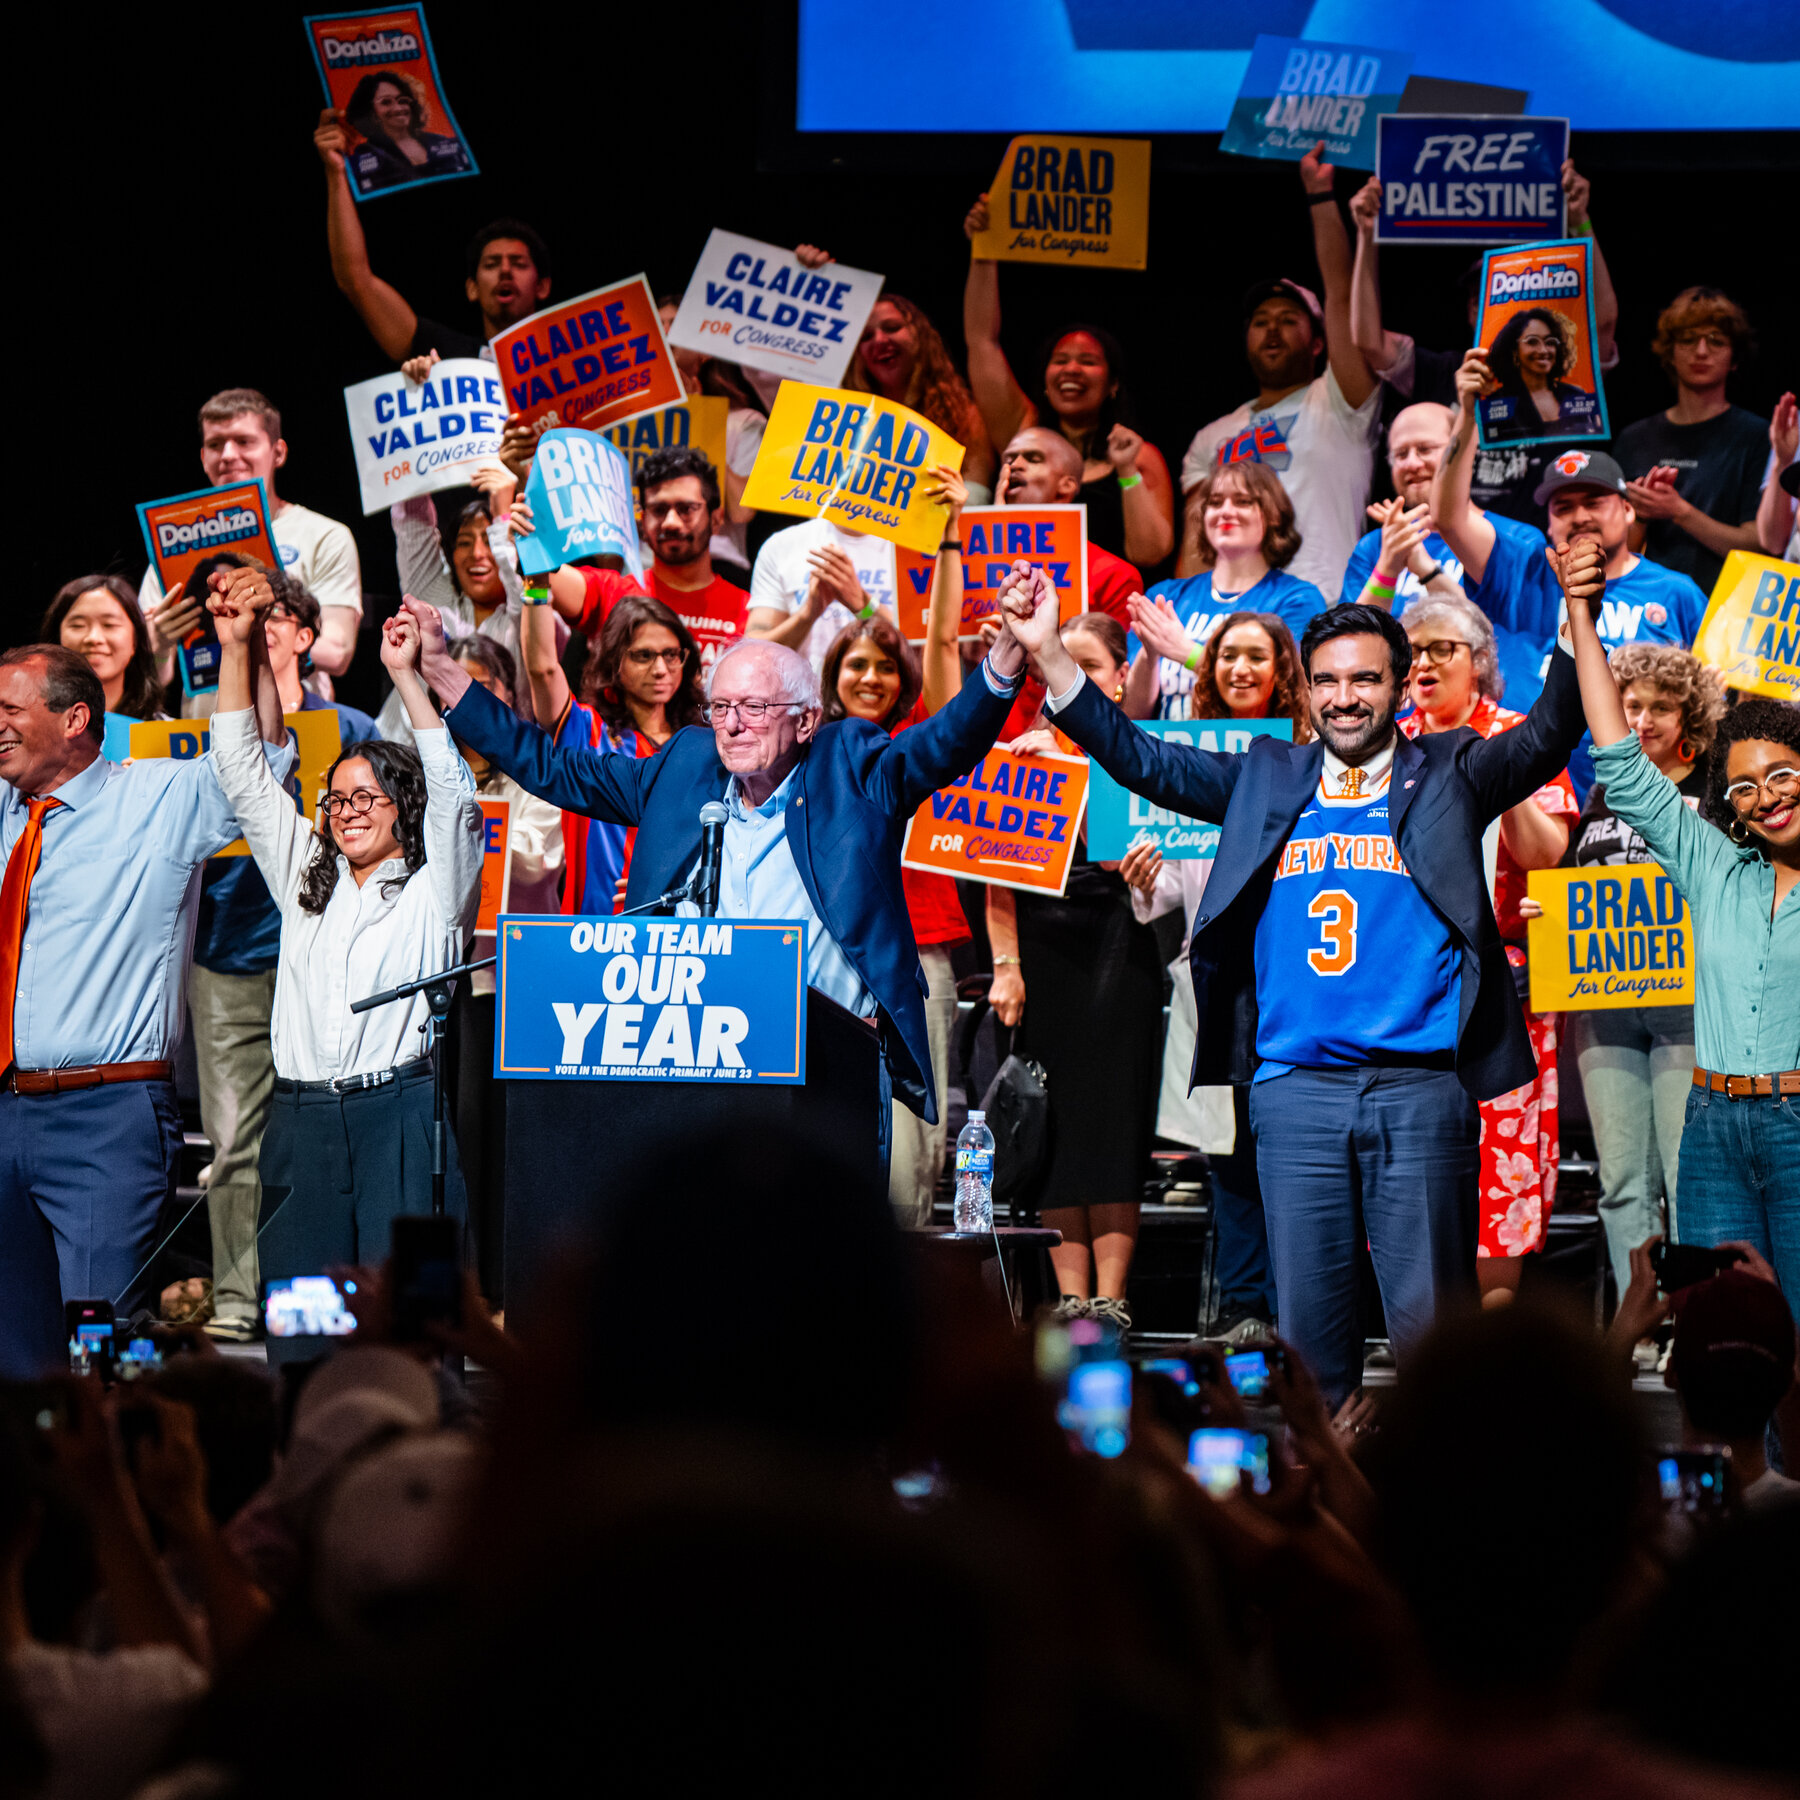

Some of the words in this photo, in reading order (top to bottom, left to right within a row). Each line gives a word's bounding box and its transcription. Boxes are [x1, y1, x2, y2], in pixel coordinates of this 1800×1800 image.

[323, 33, 418, 60] Darializa
[1279, 48, 1381, 98] BRAD
[1265, 93, 1366, 137] LANDER
[1011, 146, 1114, 195] BRAD
[1413, 132, 1535, 174] FREE
[1009, 192, 1112, 235] LANDER
[1386, 182, 1557, 217] PALESTINE
[1009, 231, 1036, 250] for
[1040, 233, 1109, 257] Congress
[725, 252, 852, 311] CLAIRE
[1492, 266, 1579, 296] Darializa
[706, 281, 850, 343] VALDEZ
[511, 300, 631, 375] CLAIRE
[699, 319, 733, 336] FOR
[733, 325, 829, 359] CONGRESS
[511, 334, 657, 411] VALDEZ
[374, 375, 501, 424] CLAIRE
[563, 368, 651, 424] CONGRESS
[804, 398, 930, 468] BRAD
[383, 461, 412, 486] FOR
[416, 440, 500, 475] CONGRES
[538, 437, 628, 502] BRAD
[789, 444, 917, 510] LANDER
[780, 484, 813, 502] for
[816, 489, 901, 527] Congress
[159, 511, 257, 547] Darializa
[163, 544, 187, 556] FOR
[192, 528, 259, 550] CONGRESS
[562, 526, 596, 553] for
[932, 791, 1069, 843] VALDEZ
[1127, 827, 1163, 849] for
[930, 834, 963, 852] FOR
[966, 836, 1054, 863] CONGRESS
[1274, 833, 1329, 882] NEW
[1568, 876, 1684, 931] BRAD
[570, 922, 636, 953] OUR
[646, 923, 733, 956] TEAM
[1307, 889, 1358, 976] 3
[1568, 928, 1685, 975] LANDER
[602, 954, 706, 1005] OUR
[1569, 977, 1601, 998] for
[1604, 975, 1685, 999] Congress
[551, 1003, 749, 1068] YEAR
[555, 1065, 578, 1075] VOTE
[579, 1066, 589, 1075] IN
[591, 1066, 609, 1076] THE
[610, 1066, 667, 1077] DEMOCRATIC
[668, 1067, 713, 1078] PRIMARY
[713, 1068, 737, 1078] JUNE
[739, 1069, 752, 1079] 23
